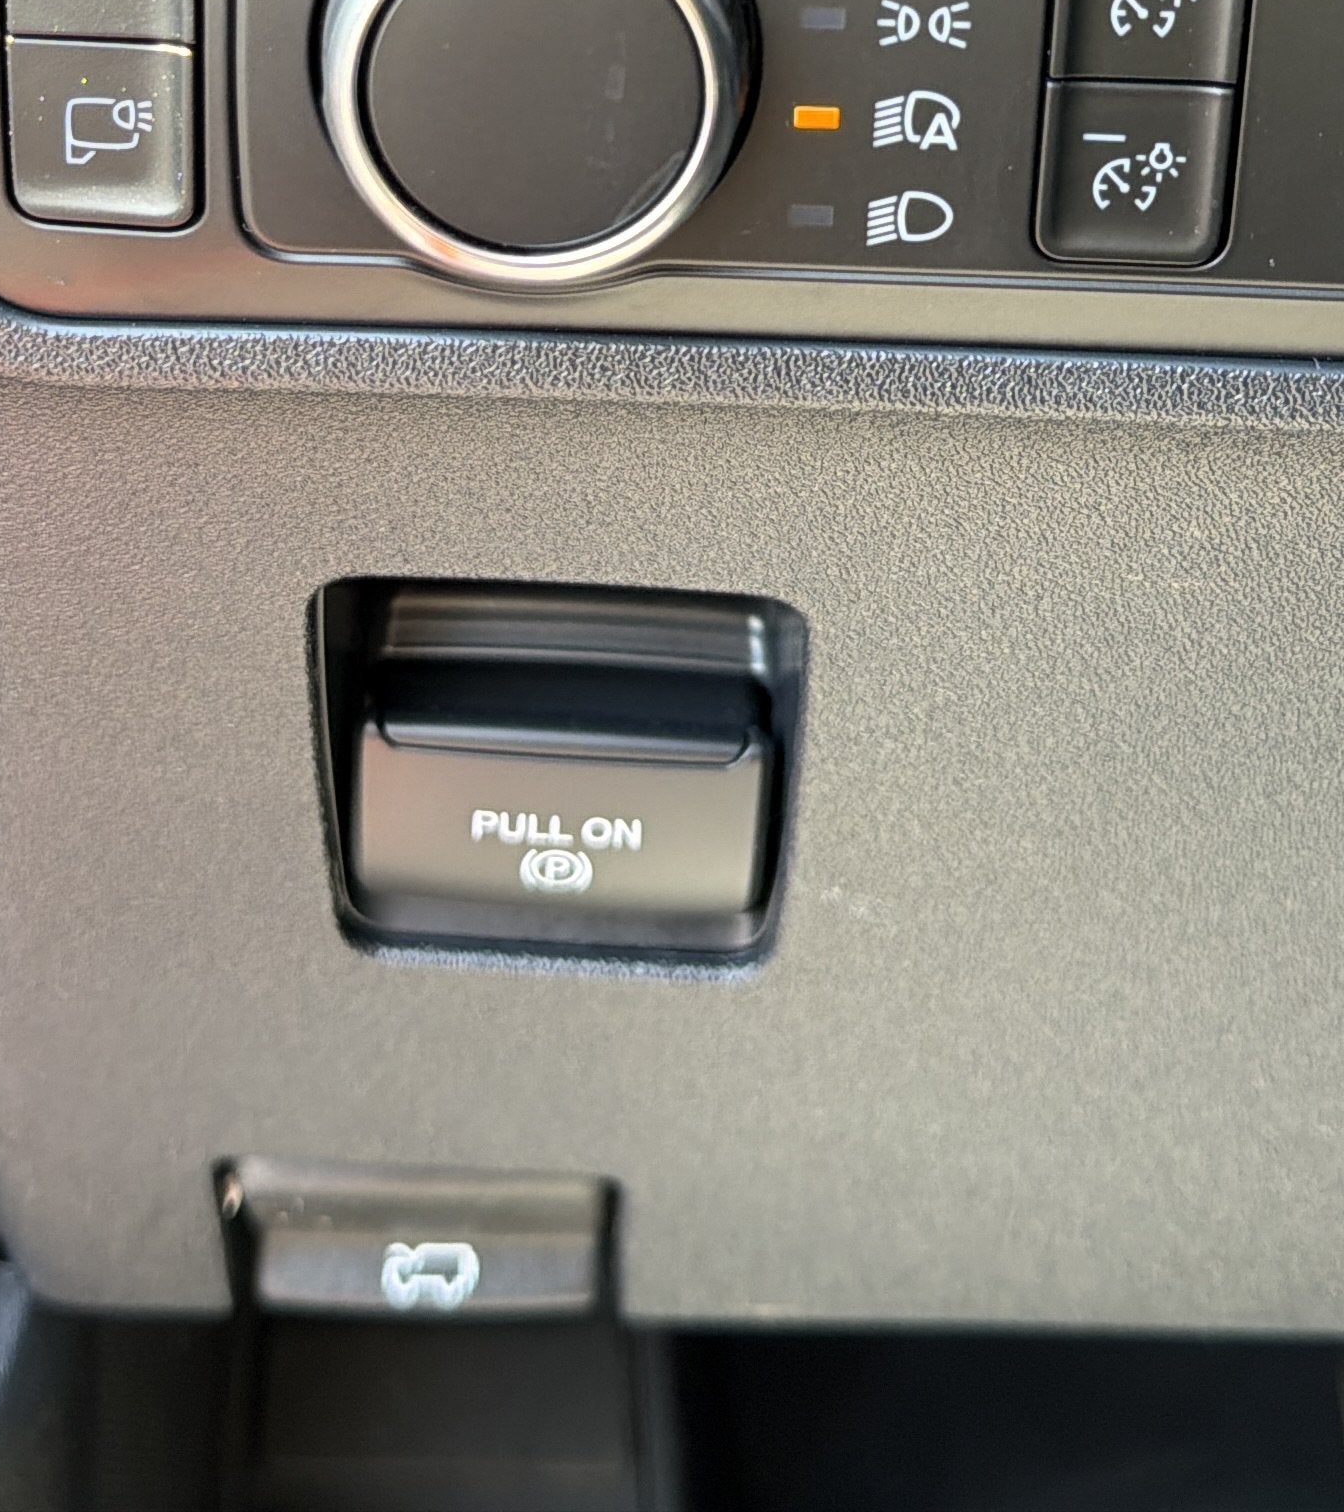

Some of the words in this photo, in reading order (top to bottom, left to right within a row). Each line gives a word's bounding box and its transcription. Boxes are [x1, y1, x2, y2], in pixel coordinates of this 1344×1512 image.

[471, 809, 574, 846] PULL
[581, 816, 642, 851] ON
[545, 856, 571, 881] P
